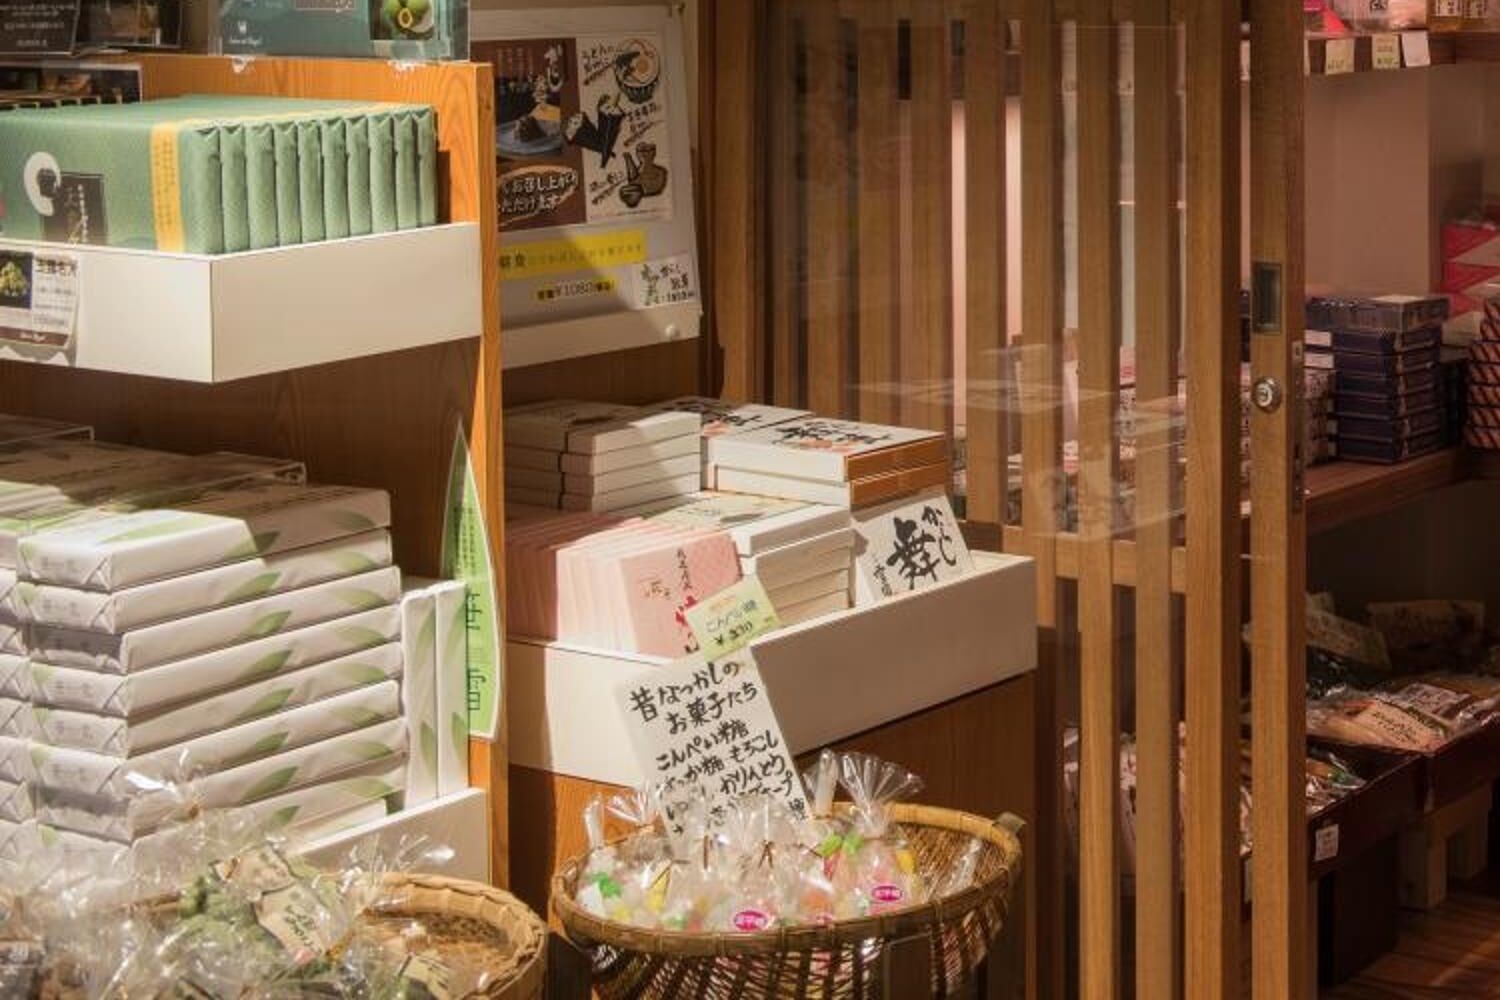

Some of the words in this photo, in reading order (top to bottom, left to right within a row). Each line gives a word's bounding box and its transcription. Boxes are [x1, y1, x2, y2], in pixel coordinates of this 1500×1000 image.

[666, 681, 758, 735] お菓子たち
[656, 719, 749, 771] こんぺい糖
[730, 730, 779, 763] もろこし
